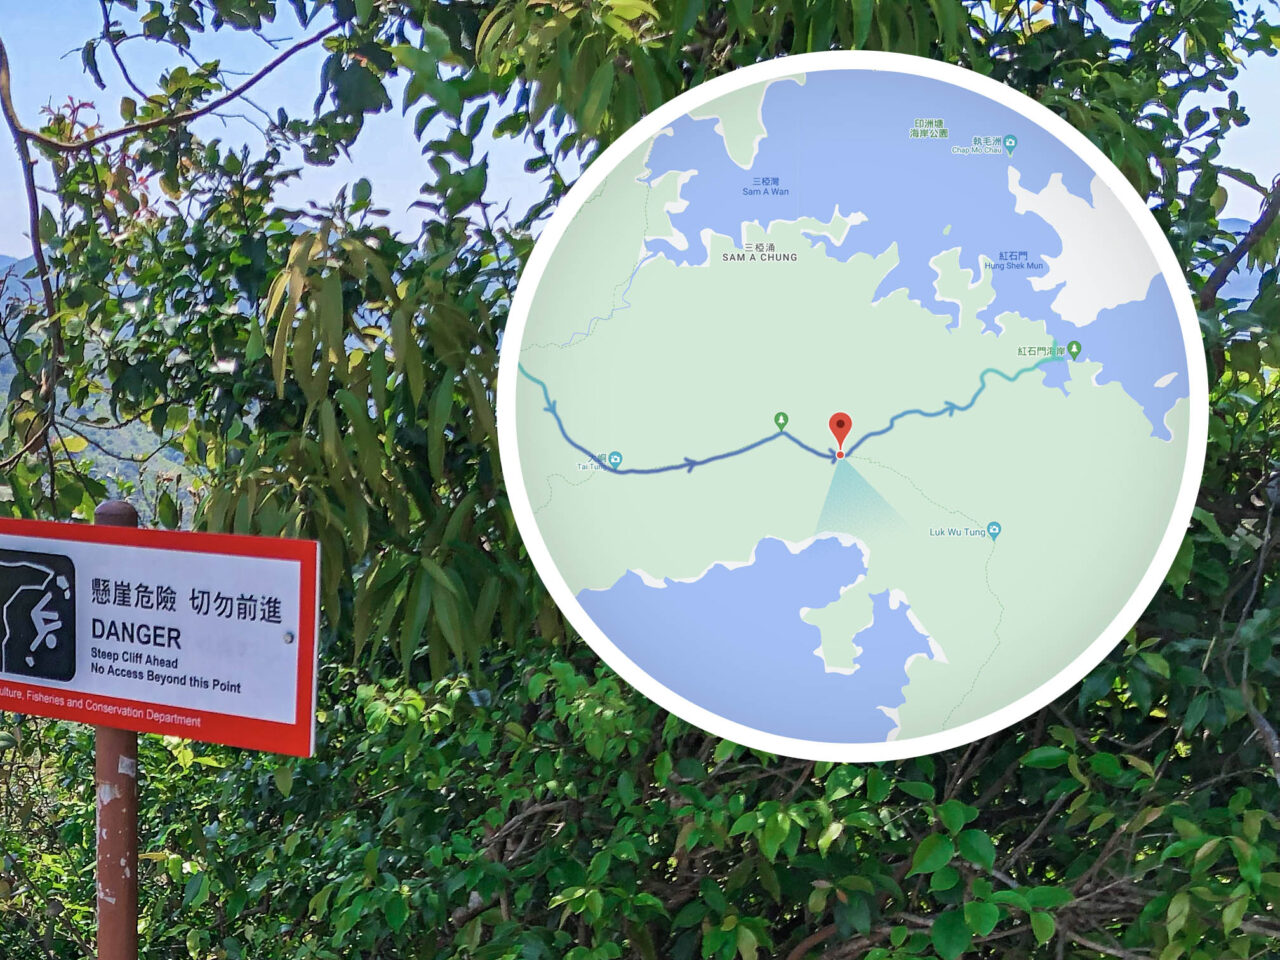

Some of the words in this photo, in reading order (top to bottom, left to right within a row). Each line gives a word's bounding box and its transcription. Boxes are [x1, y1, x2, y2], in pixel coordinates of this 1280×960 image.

[91, 577, 177, 612] 懸崖危險
[189, 587, 282, 624] 切勿前進
[91, 617, 182, 650] DANGER
[90, 646, 119, 663] Steep
[121, 651, 144, 665] Cliff
[145, 656, 179, 670] Ahead
[90, 662, 105, 675] No
[107, 665, 144, 681] Access
[146, 669, 187, 687] Beyond
[189, 675, 210, 690] this
[212, 679, 242, 694] Point
[26, 689, 65, 706] Fisheries
[66, 698, 83, 709] and
[85, 699, 144, 719] Conservation
[146, 708, 202, 728] Department
